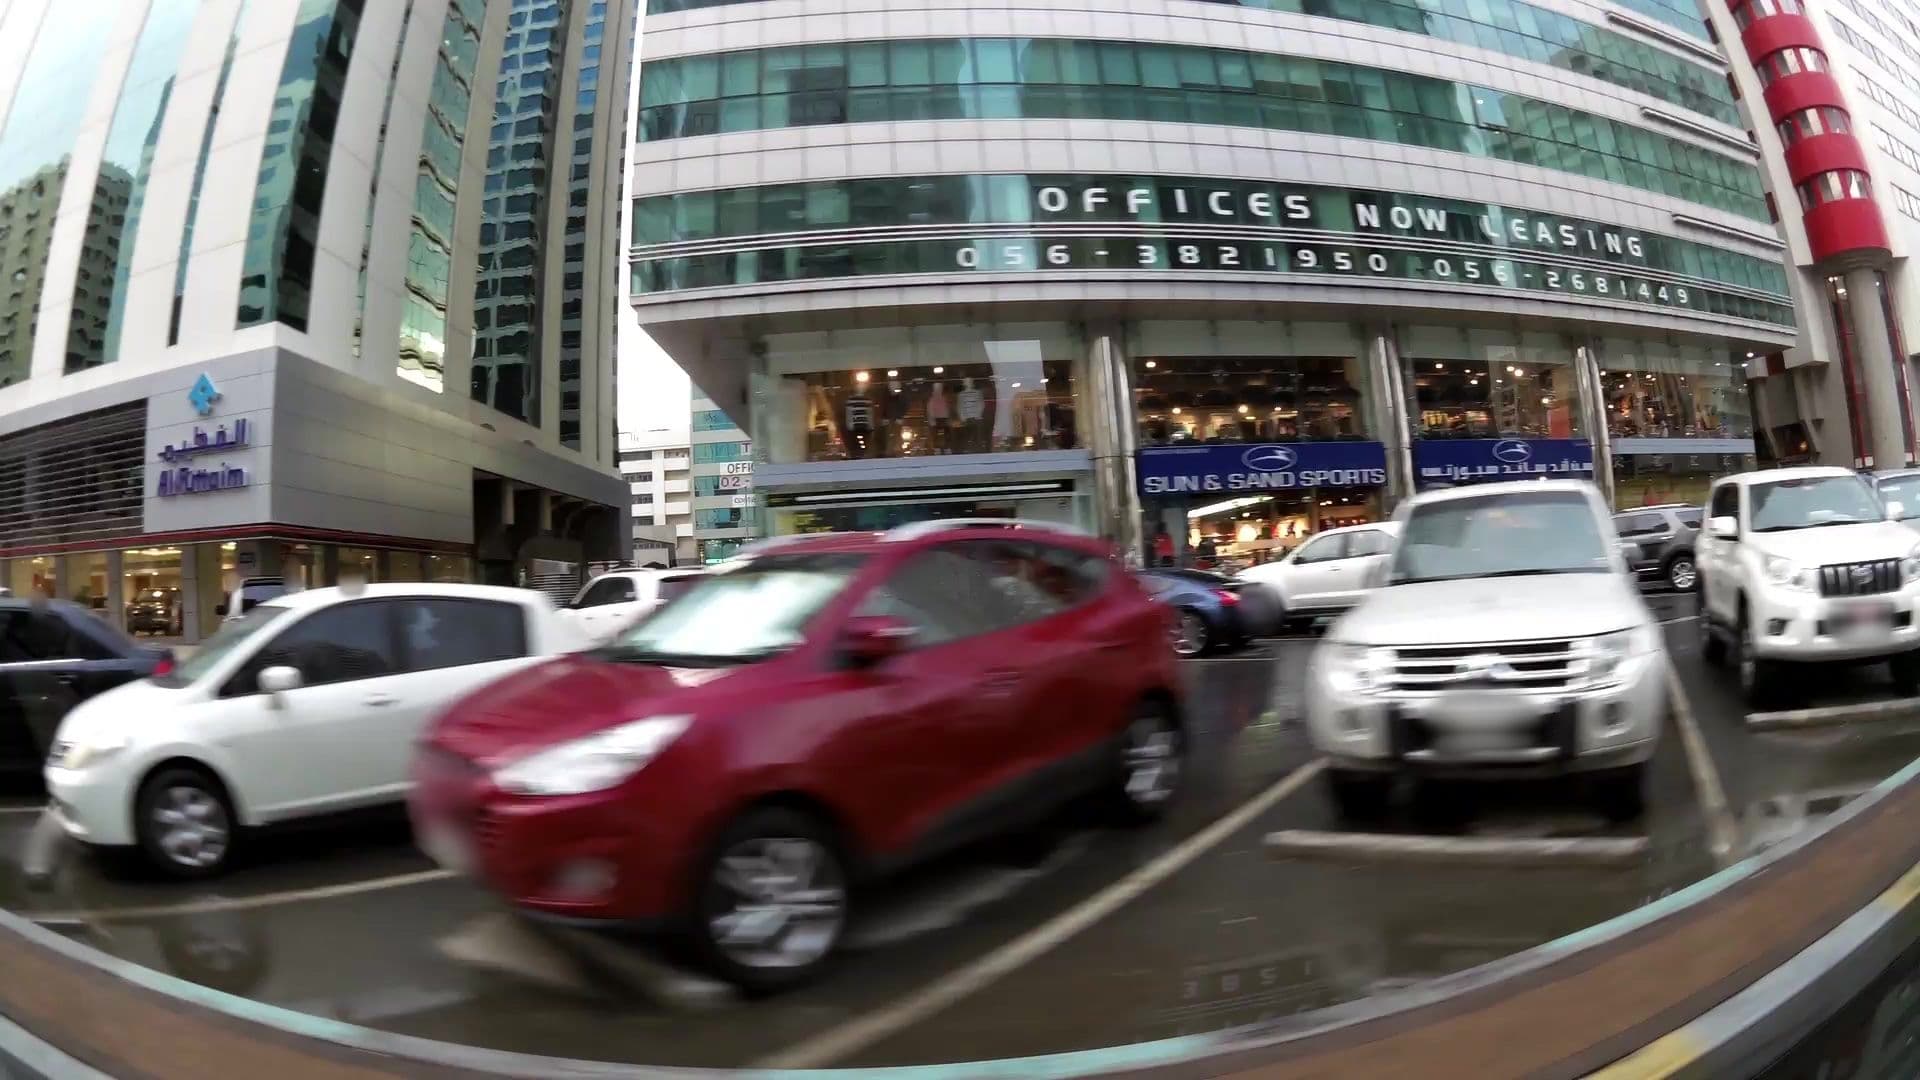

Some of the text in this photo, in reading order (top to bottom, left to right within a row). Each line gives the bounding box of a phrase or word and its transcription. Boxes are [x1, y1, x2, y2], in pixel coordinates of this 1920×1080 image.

[1037, 186, 1643, 258] OFFICES NOW LEASING
[1144, 468, 1386, 493] SUN & SAND SPORTS
